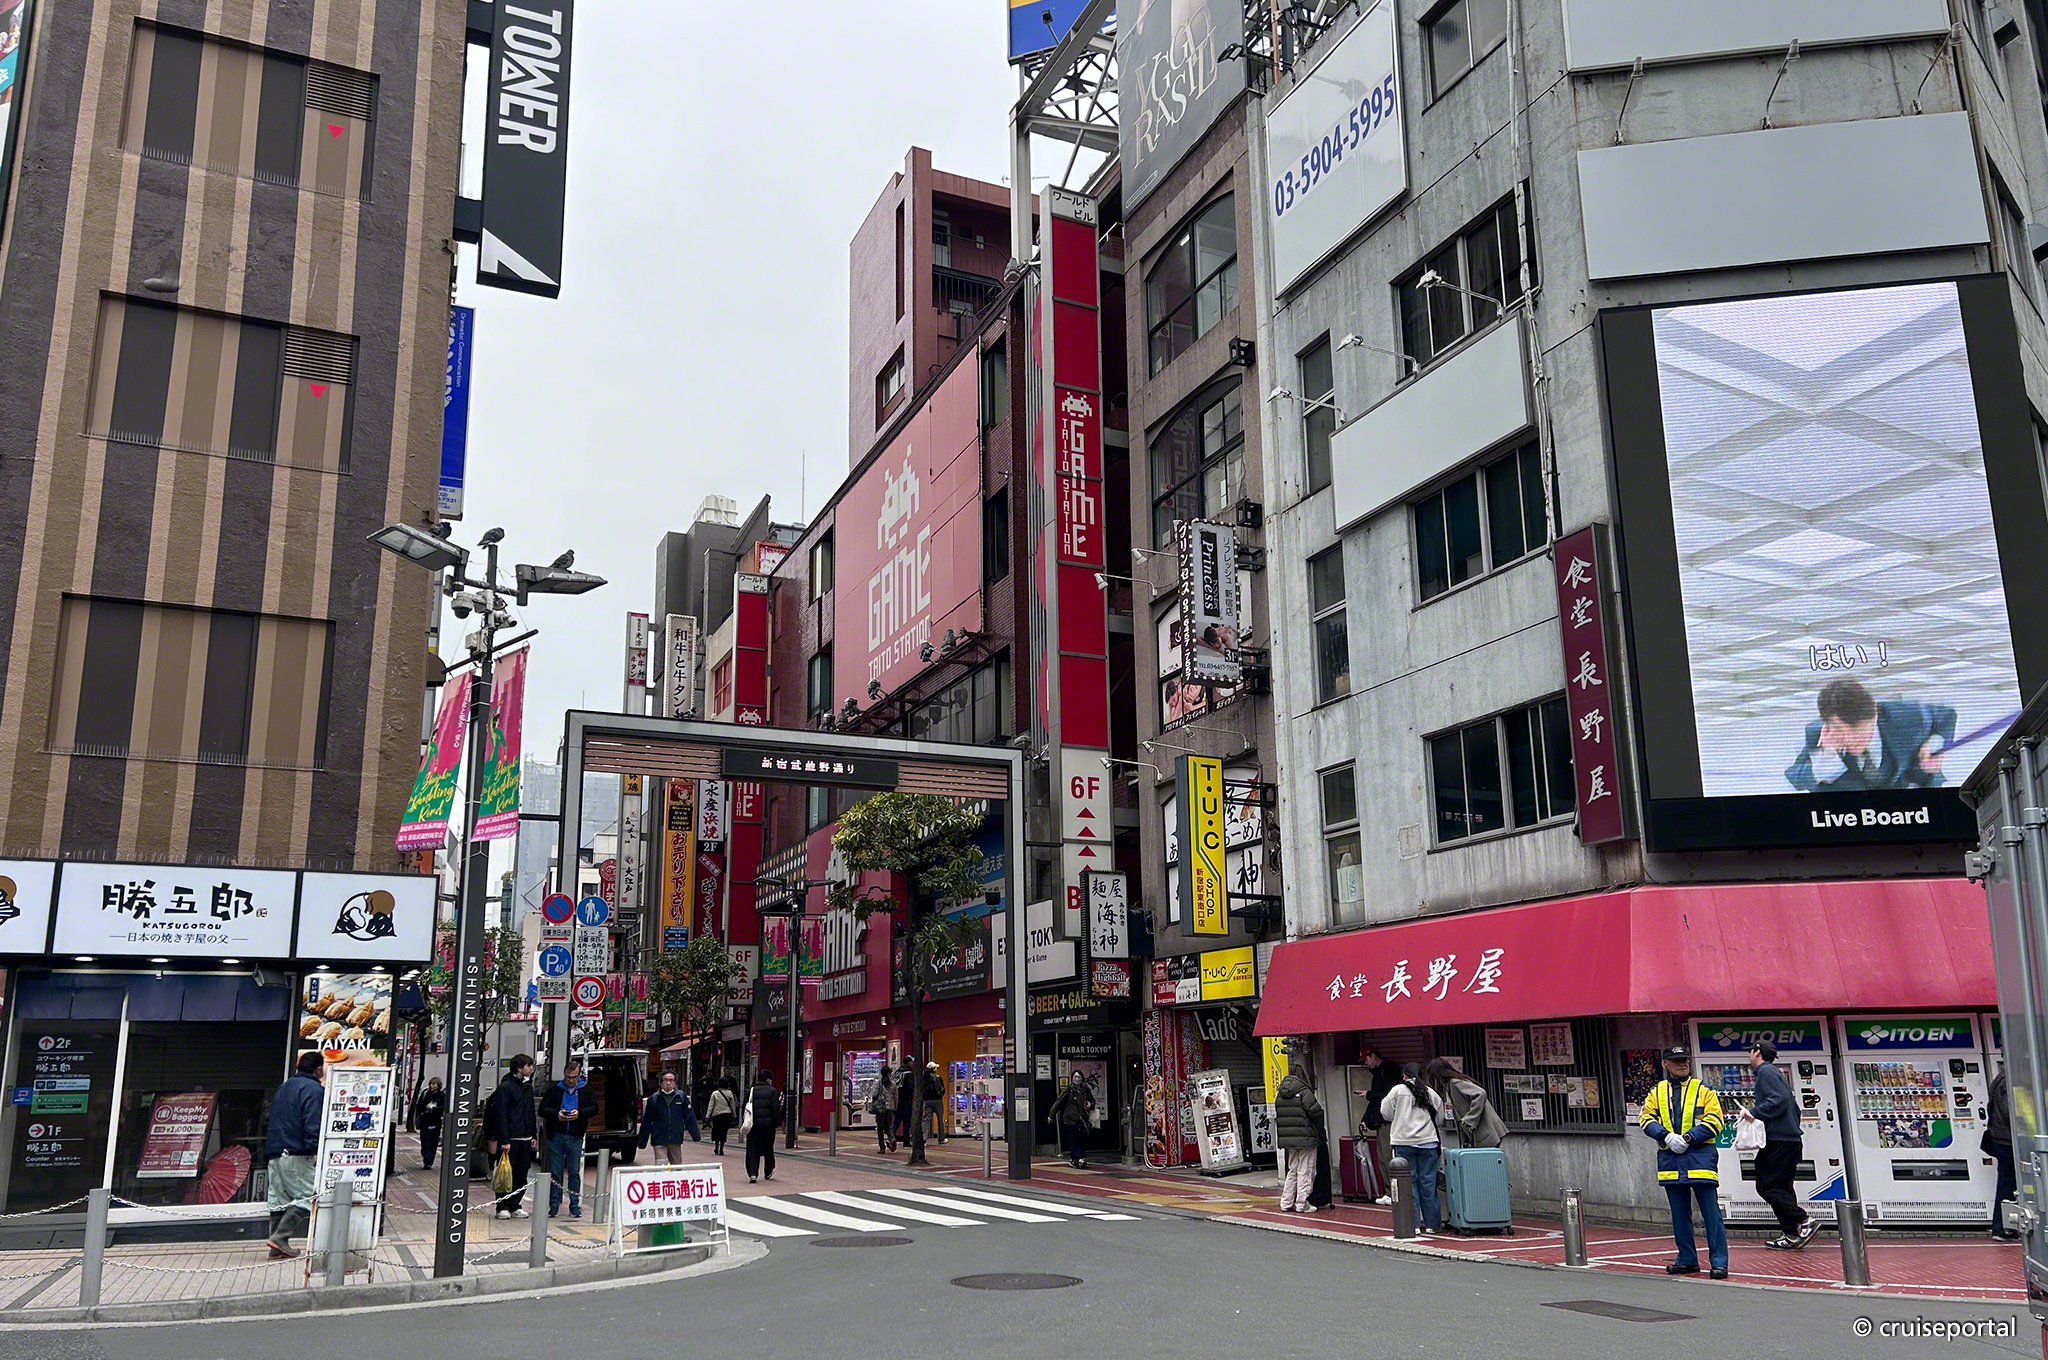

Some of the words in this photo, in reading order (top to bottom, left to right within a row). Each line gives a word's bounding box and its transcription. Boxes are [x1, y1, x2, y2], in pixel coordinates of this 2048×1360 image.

[498, 5, 562, 153] TOWER
[1275, 73, 1396, 217] 03-5904-5995
[1052, 190, 1090, 207] ワールド
[1073, 209, 1096, 223] ビル
[1070, 420, 1095, 557] GAME
[1063, 479, 1071, 555] STATION
[1179, 521, 1190, 596] プリンセス
[1223, 536, 1233, 585] リフレッシュ
[739, 575, 765, 584] ワールド
[1202, 539, 1215, 610] Princess
[753, 584, 767, 593] ビル
[868, 523, 931, 653] GAME
[1225, 589, 1234, 617] 新宿店
[868, 649, 892, 680] TAITO
[893, 613, 931, 665] STATION
[1225, 649, 1238, 662] 3F
[761, 757, 855, 774] 新宿武蔵野通り
[1071, 776, 1100, 799] 6F
[703, 780, 719, 839] 水産浜焼
[1811, 808, 1857, 828] Live
[1861, 806, 1929, 827] Board
[704, 842, 718, 852] 2F
[624, 866, 635, 895] 大江戸
[1092, 877, 1124, 899] 麺屋
[102, 880, 254, 921] 勝五郎
[1196, 867, 1206, 928] 新宿駅東南口店
[1206, 878, 1214, 918] SHOP
[143, 922, 222, 930] KATSUGOROU
[1098, 901, 1119, 955] 海神
[127, 932, 229, 944] 日本の焼き芋屋の父
[546, 954, 559, 973] P
[735, 951, 752, 962] 6F
[1096, 961, 1117, 972] Pizza
[1094, 972, 1126, 983] Highball
[1325, 973, 1368, 1001] 食堂
[1380, 948, 1505, 1003] 長野屋
[580, 985, 598, 999] 30
[461, 964, 479, 1062] SHINJUKU
[1036, 994, 1059, 1013] BEER
[1194, 1011, 1238, 1041] Lad's
[1741, 1030, 1775, 1043] ITO
[1778, 1029, 1804, 1043] EN
[1889, 1028, 1925, 1042] ITO
[1927, 1027, 1954, 1041] EN
[55, 1037, 71, 1049] 2F
[316, 1039, 371, 1050] TAIYAKI
[1062, 1046, 1085, 1054] EXBAR
[171, 1114, 209, 1122] Baggage
[454, 1073, 472, 1176] RAMBLING
[47, 1124, 61, 1136] 1F
[647, 1178, 719, 1202] 車両通行止
[450, 1189, 465, 1244] ROAD
